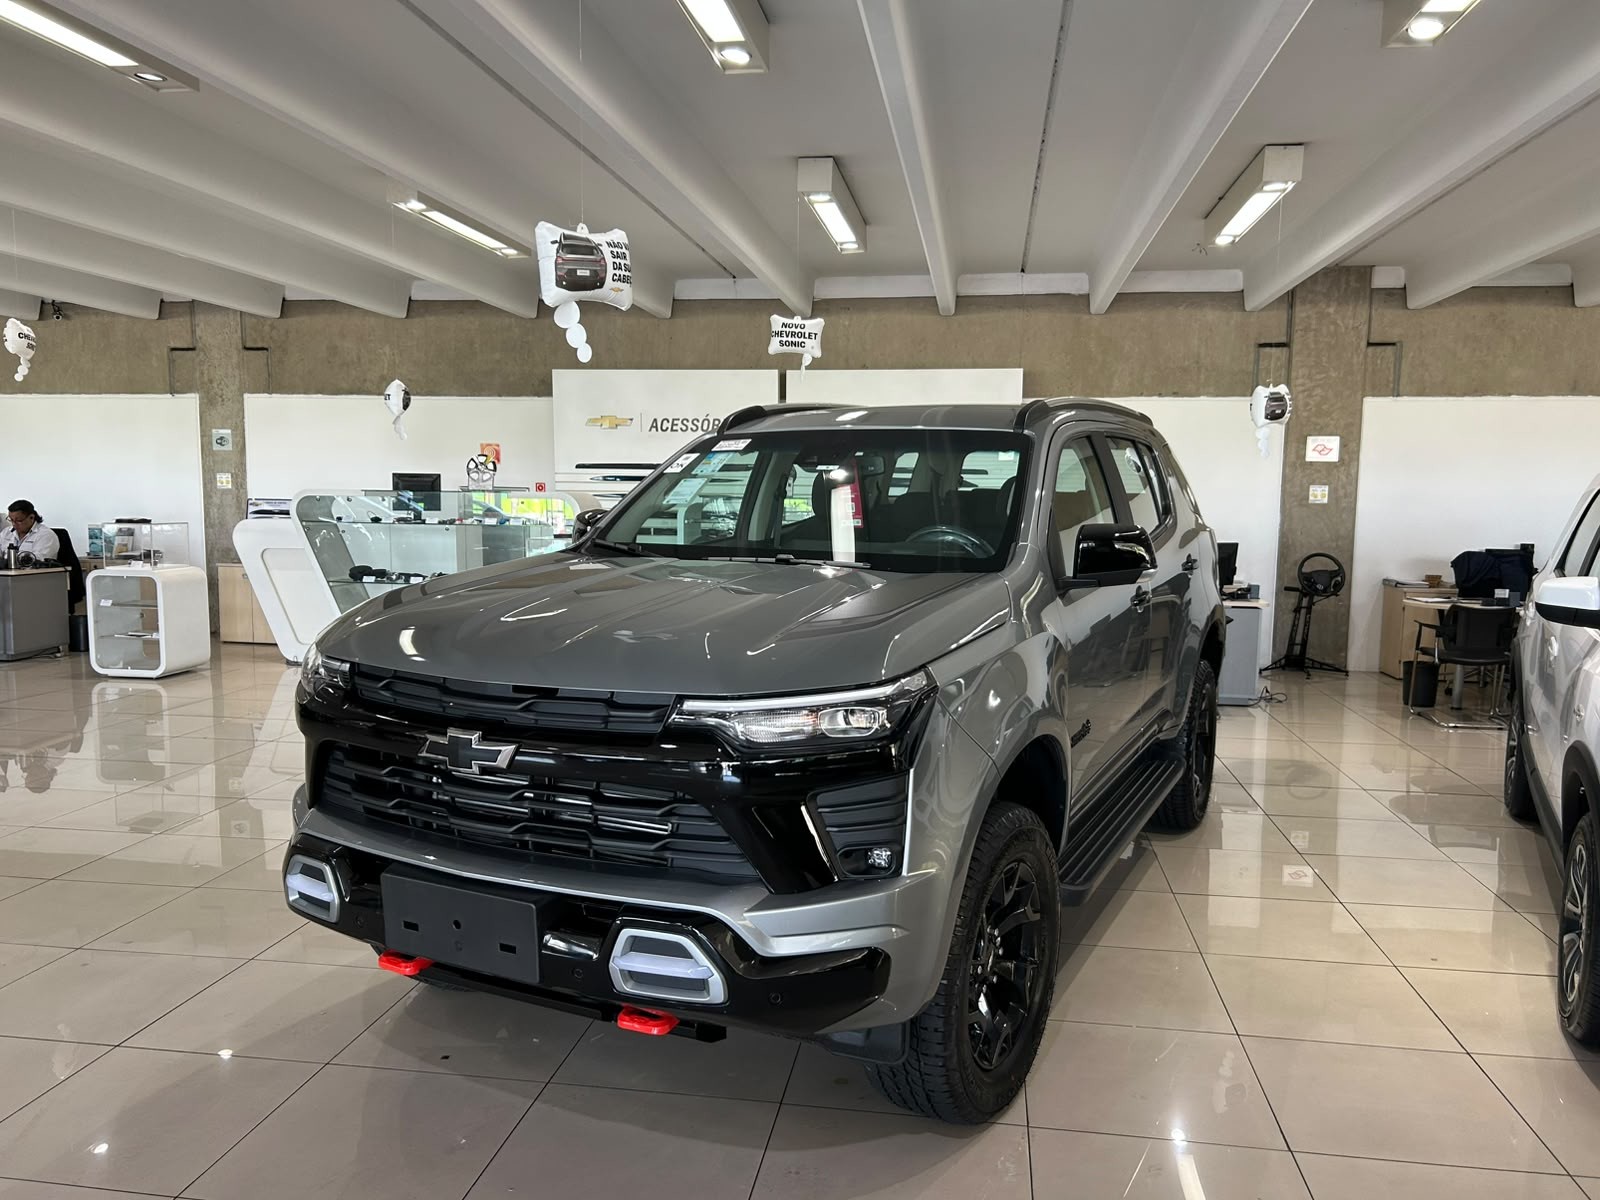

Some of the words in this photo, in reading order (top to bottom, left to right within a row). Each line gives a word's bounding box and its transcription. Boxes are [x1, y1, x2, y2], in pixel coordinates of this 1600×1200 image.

[610, 250, 627, 260] SAIR
[612, 261, 623, 271] DA
[612, 273, 632, 286] CABE
[781, 322, 806, 330] NOVO
[779, 340, 806, 349] SONIC
